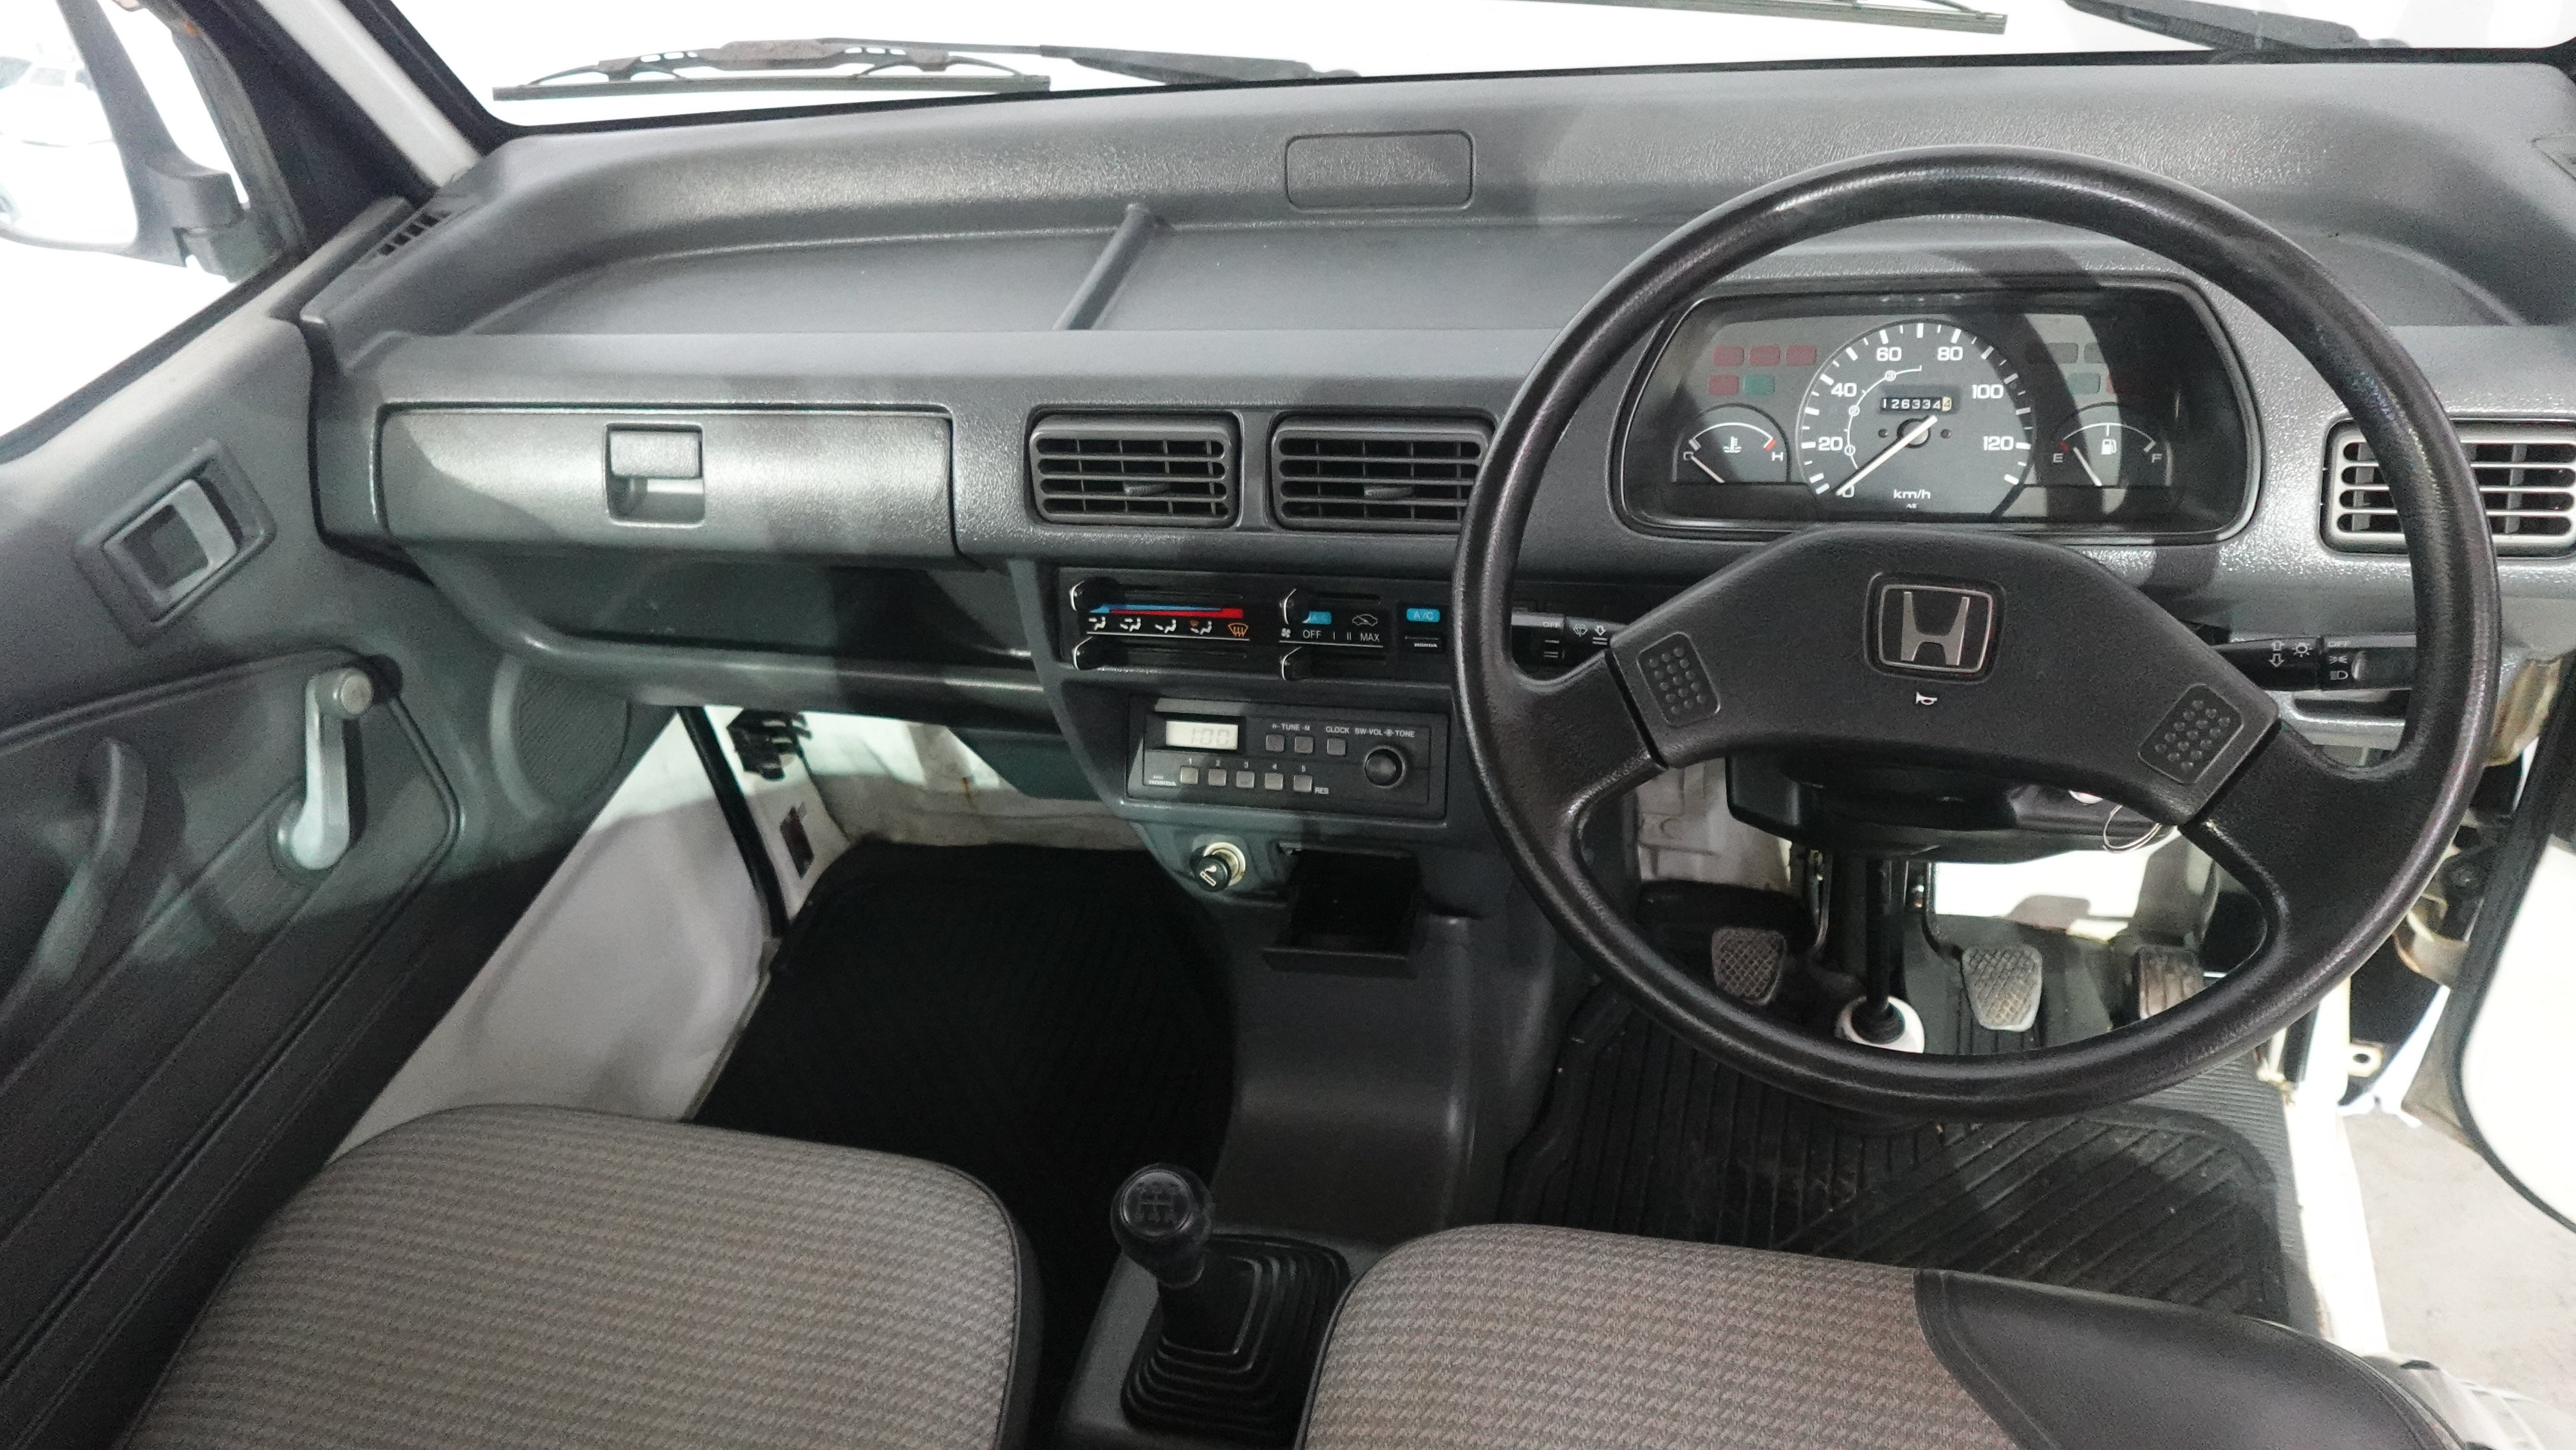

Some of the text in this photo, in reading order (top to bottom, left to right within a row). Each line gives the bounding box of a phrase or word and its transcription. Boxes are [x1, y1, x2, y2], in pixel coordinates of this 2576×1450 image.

[1876, 346, 1902, 361] 60
[1937, 346, 1963, 361] 80
[1831, 382, 1857, 397] 40
[1972, 384, 2004, 399] 100
[1818, 436, 1843, 451] 20
[1983, 436, 2014, 451] 120
[1771, 451, 1783, 461] H
[2053, 453, 2064, 463] E
[2151, 453, 2163, 463] F
[1893, 489, 1931, 499] km/h
[1414, 611, 1434, 620] A/C
[1303, 630, 1321, 639] OFF
[1360, 632, 1380, 642] MAX
[1326, 726, 1350, 734] CLOCK
[1244, 760, 1249, 768] 3
